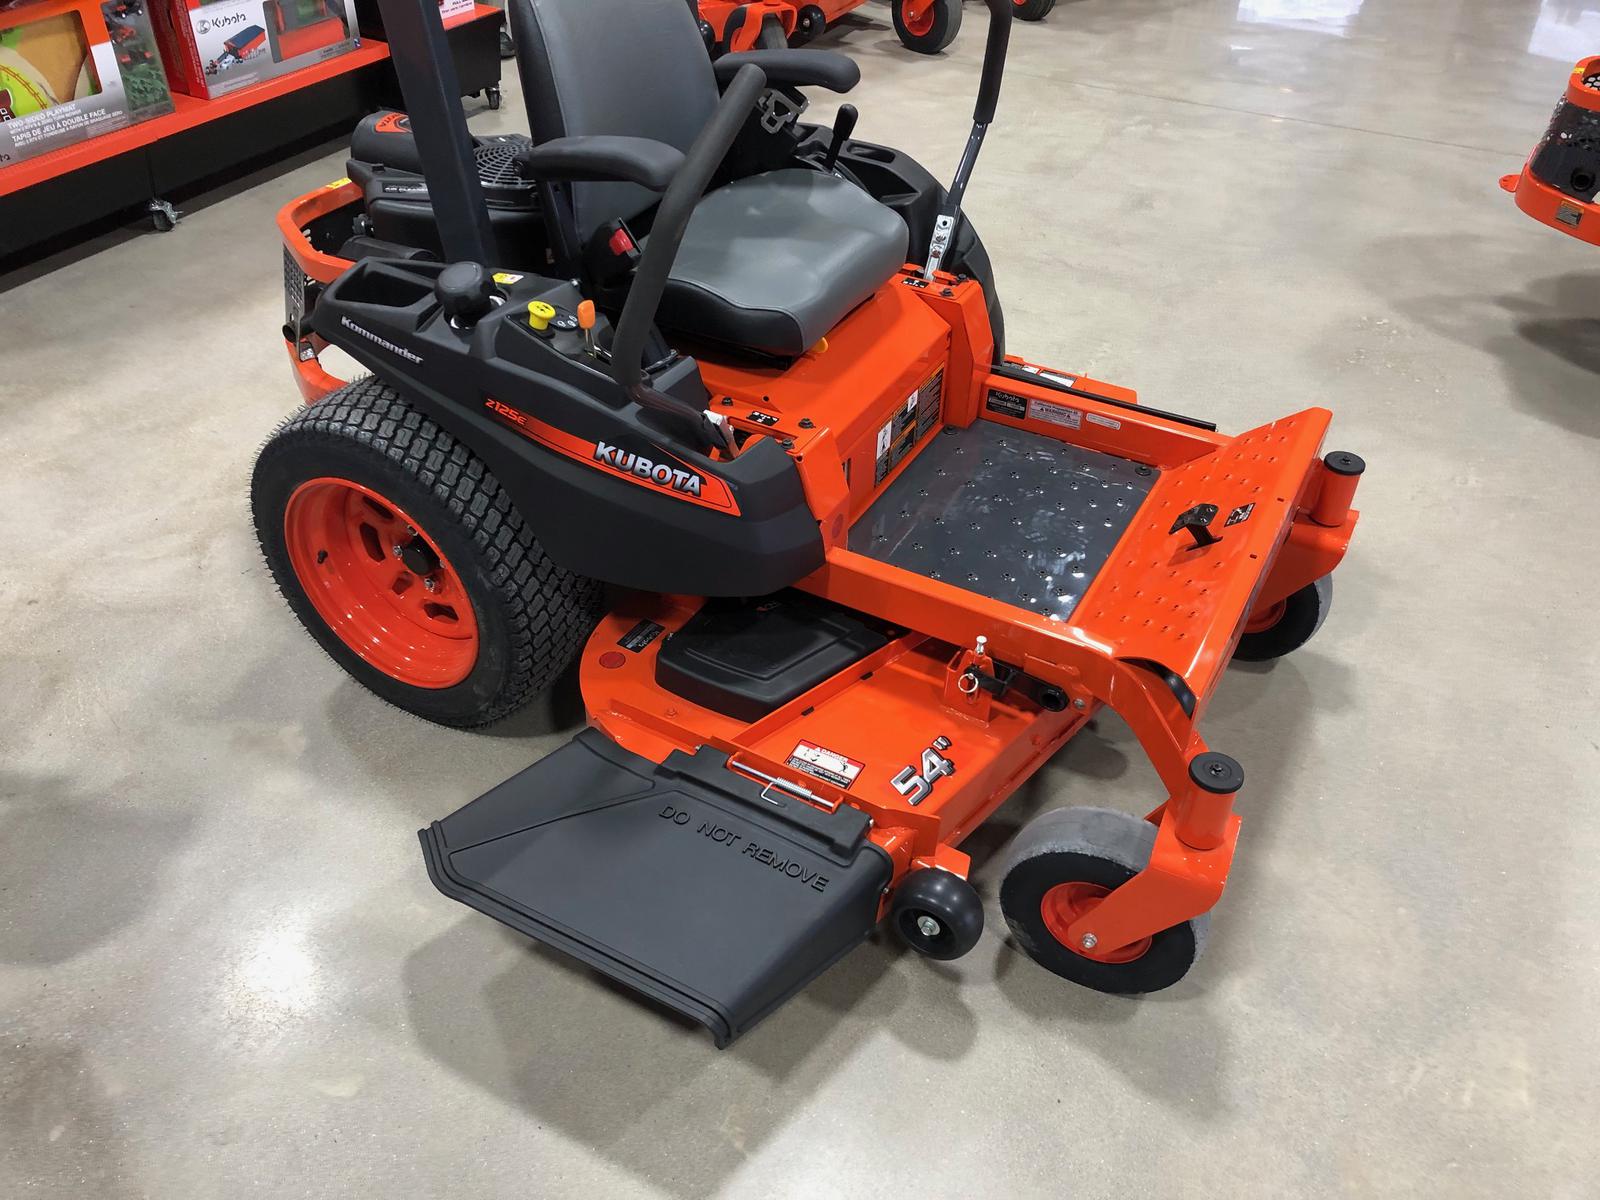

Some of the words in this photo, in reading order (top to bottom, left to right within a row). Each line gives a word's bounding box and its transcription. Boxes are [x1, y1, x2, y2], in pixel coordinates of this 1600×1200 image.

[211, 12, 247, 28] Kubota
[11, 132, 31, 142] TAPIS
[41, 124, 55, 133] JEU
[61, 113, 88, 127] DOUBLE
[88, 109, 105, 118] FACE
[341, 316, 424, 364] Kommander
[595, 440, 701, 496] KUBOTA
[659, 806, 691, 825] DO
[697, 821, 742, 847] NOT
[742, 842, 830, 893] REMOVE
